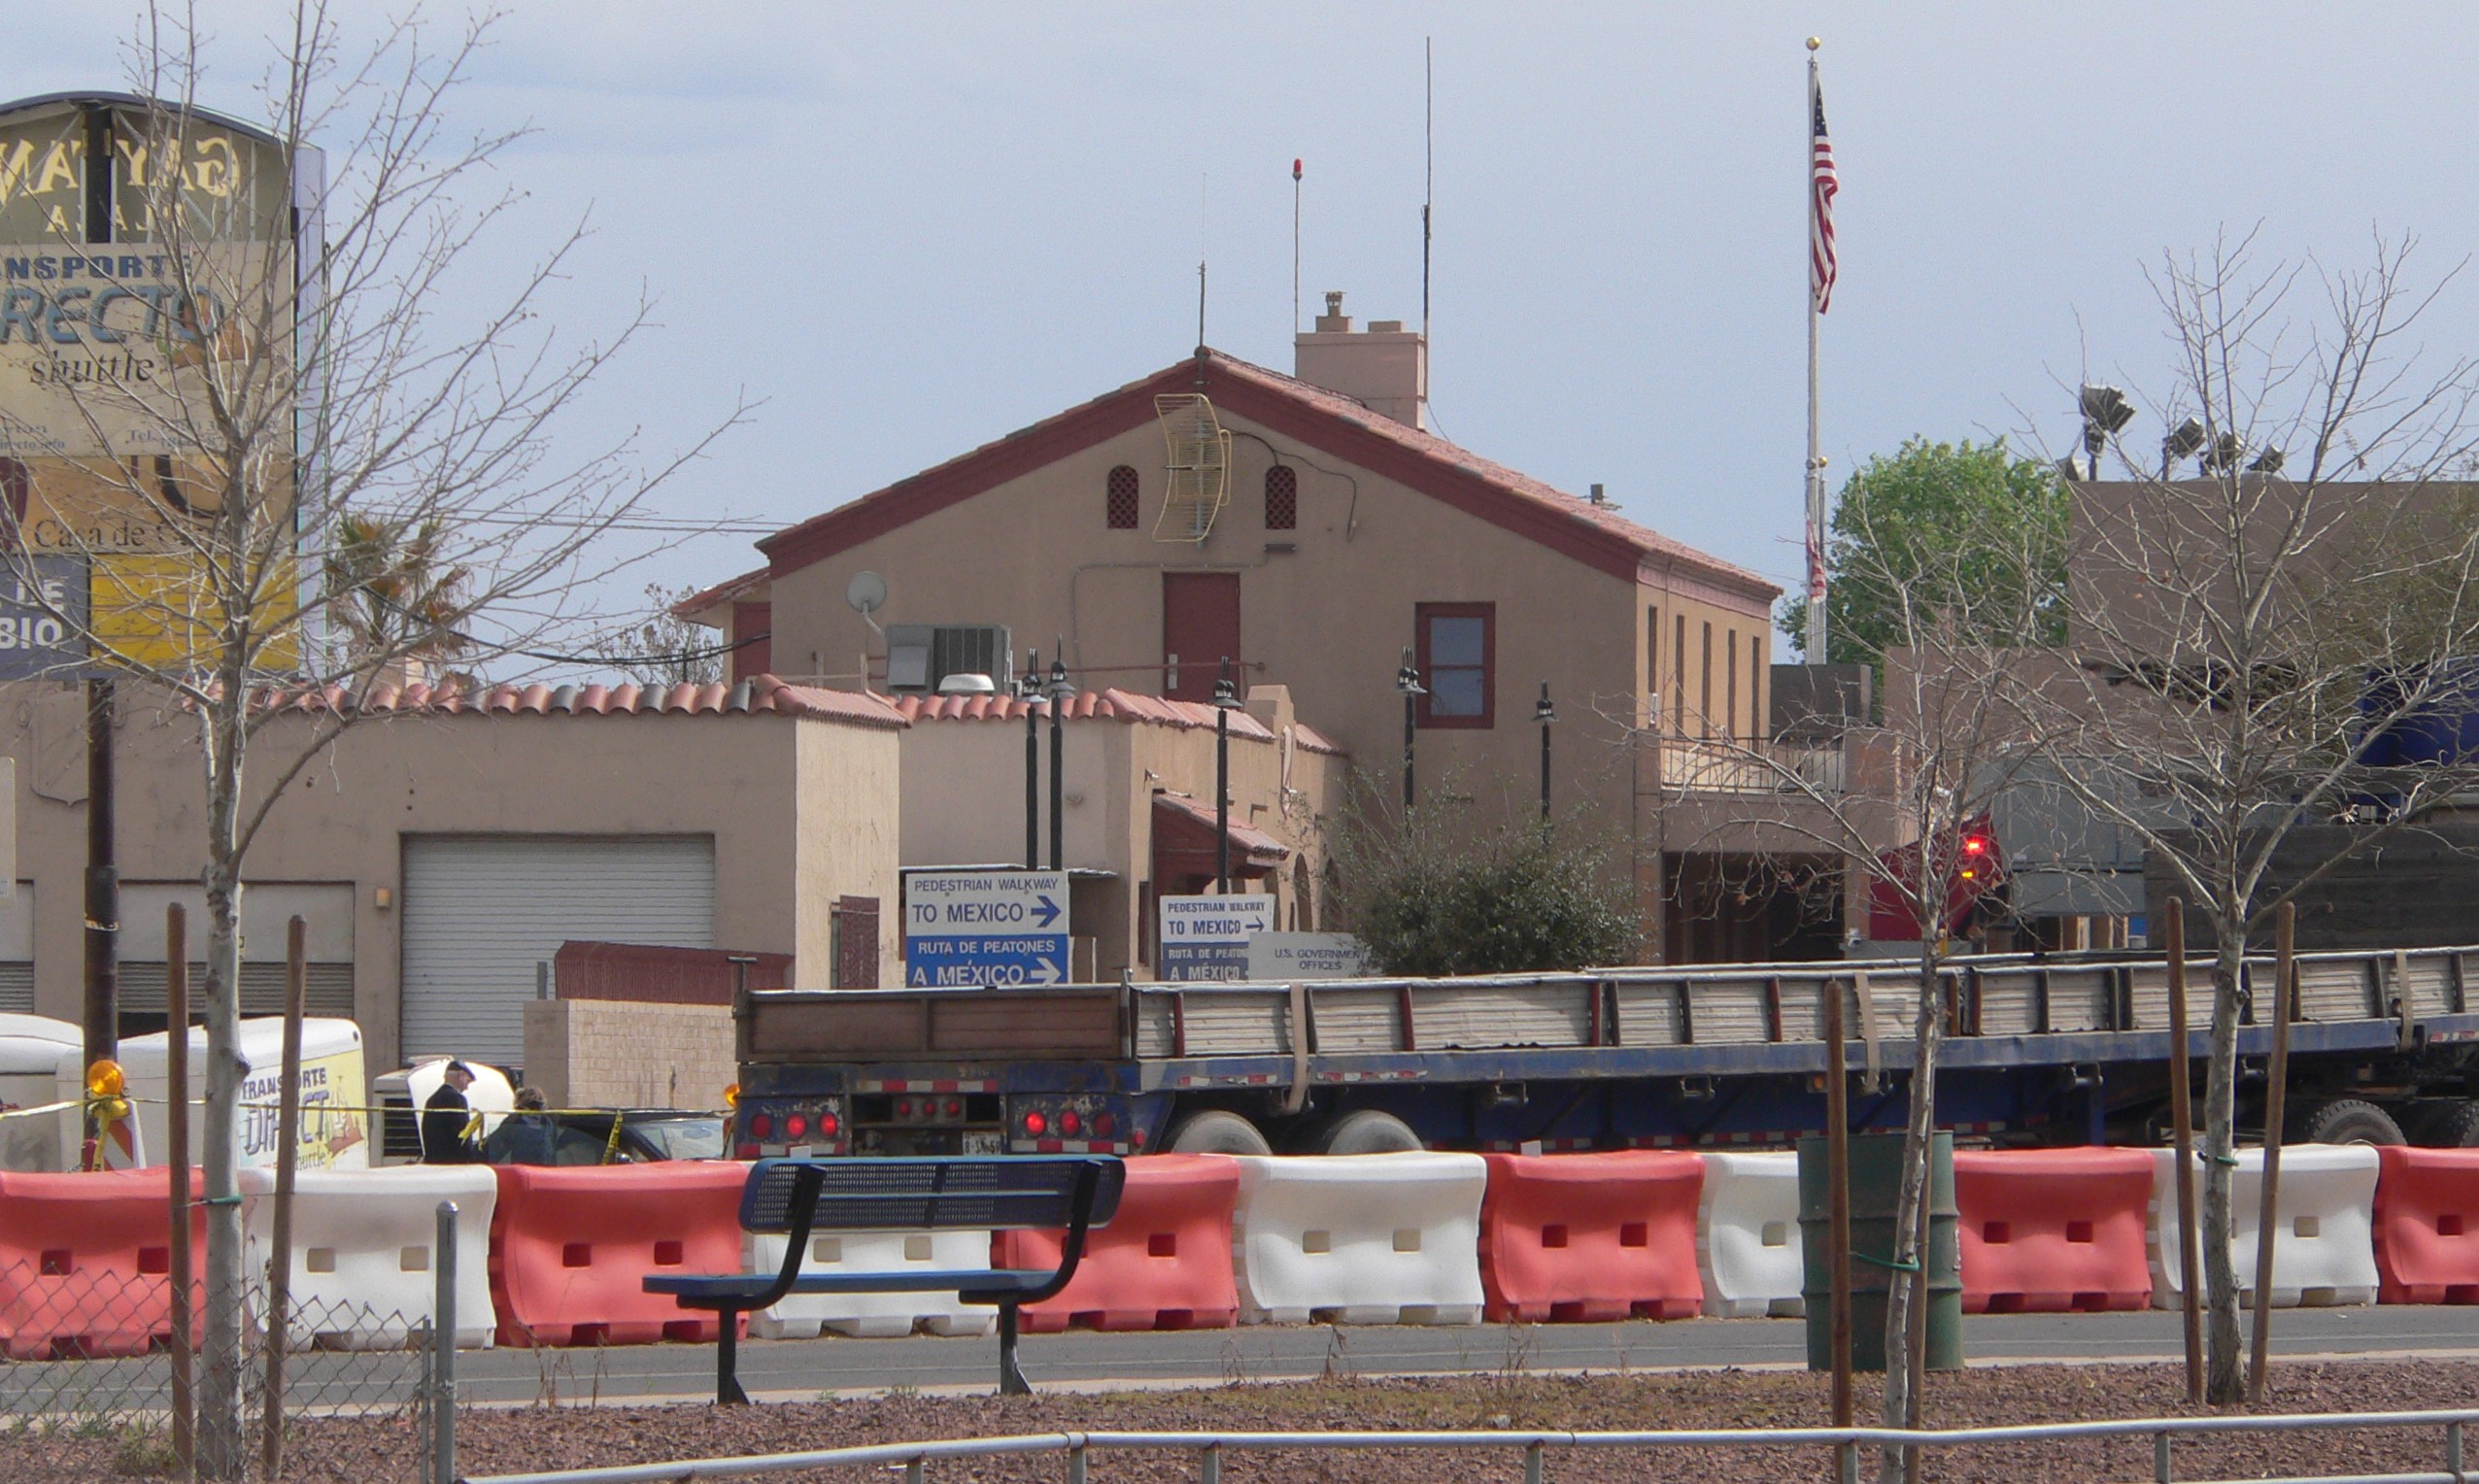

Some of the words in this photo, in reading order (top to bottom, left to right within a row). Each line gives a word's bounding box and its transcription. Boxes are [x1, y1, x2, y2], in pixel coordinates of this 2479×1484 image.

[0, 255, 190, 280] NSPORT
[30, 350, 154, 384] shuttle
[34, 519, 102, 548] Casa
[114, 521, 146, 546] de
[914, 879, 992, 892] PEDESTRIAN
[999, 878, 1058, 891] WALKWAY
[912, 904, 937, 923] TO
[947, 903, 1024, 923] MEXICO
[1168, 902, 1226, 913] PEDESTRIAN
[1229, 901, 1265, 912] WALKWAY
[1168, 921, 1185, 935] TO
[1193, 920, 1241, 935] MEXICO
[918, 941, 953, 955] RUTA
[959, 941, 977, 954] DE
[983, 940, 1056, 953] PEATONES
[1169, 948, 1193, 960] RUTA
[1199, 949, 1210, 960] DE
[1274, 948, 1294, 959] U.S.
[912, 966, 928, 986] A
[936, 959, 1025, 986] MÉXICO
[1170, 966, 1180, 981] A
[1188, 961, 1240, 981] MÉXICO
[1299, 961, 1342, 970] OFFICES
